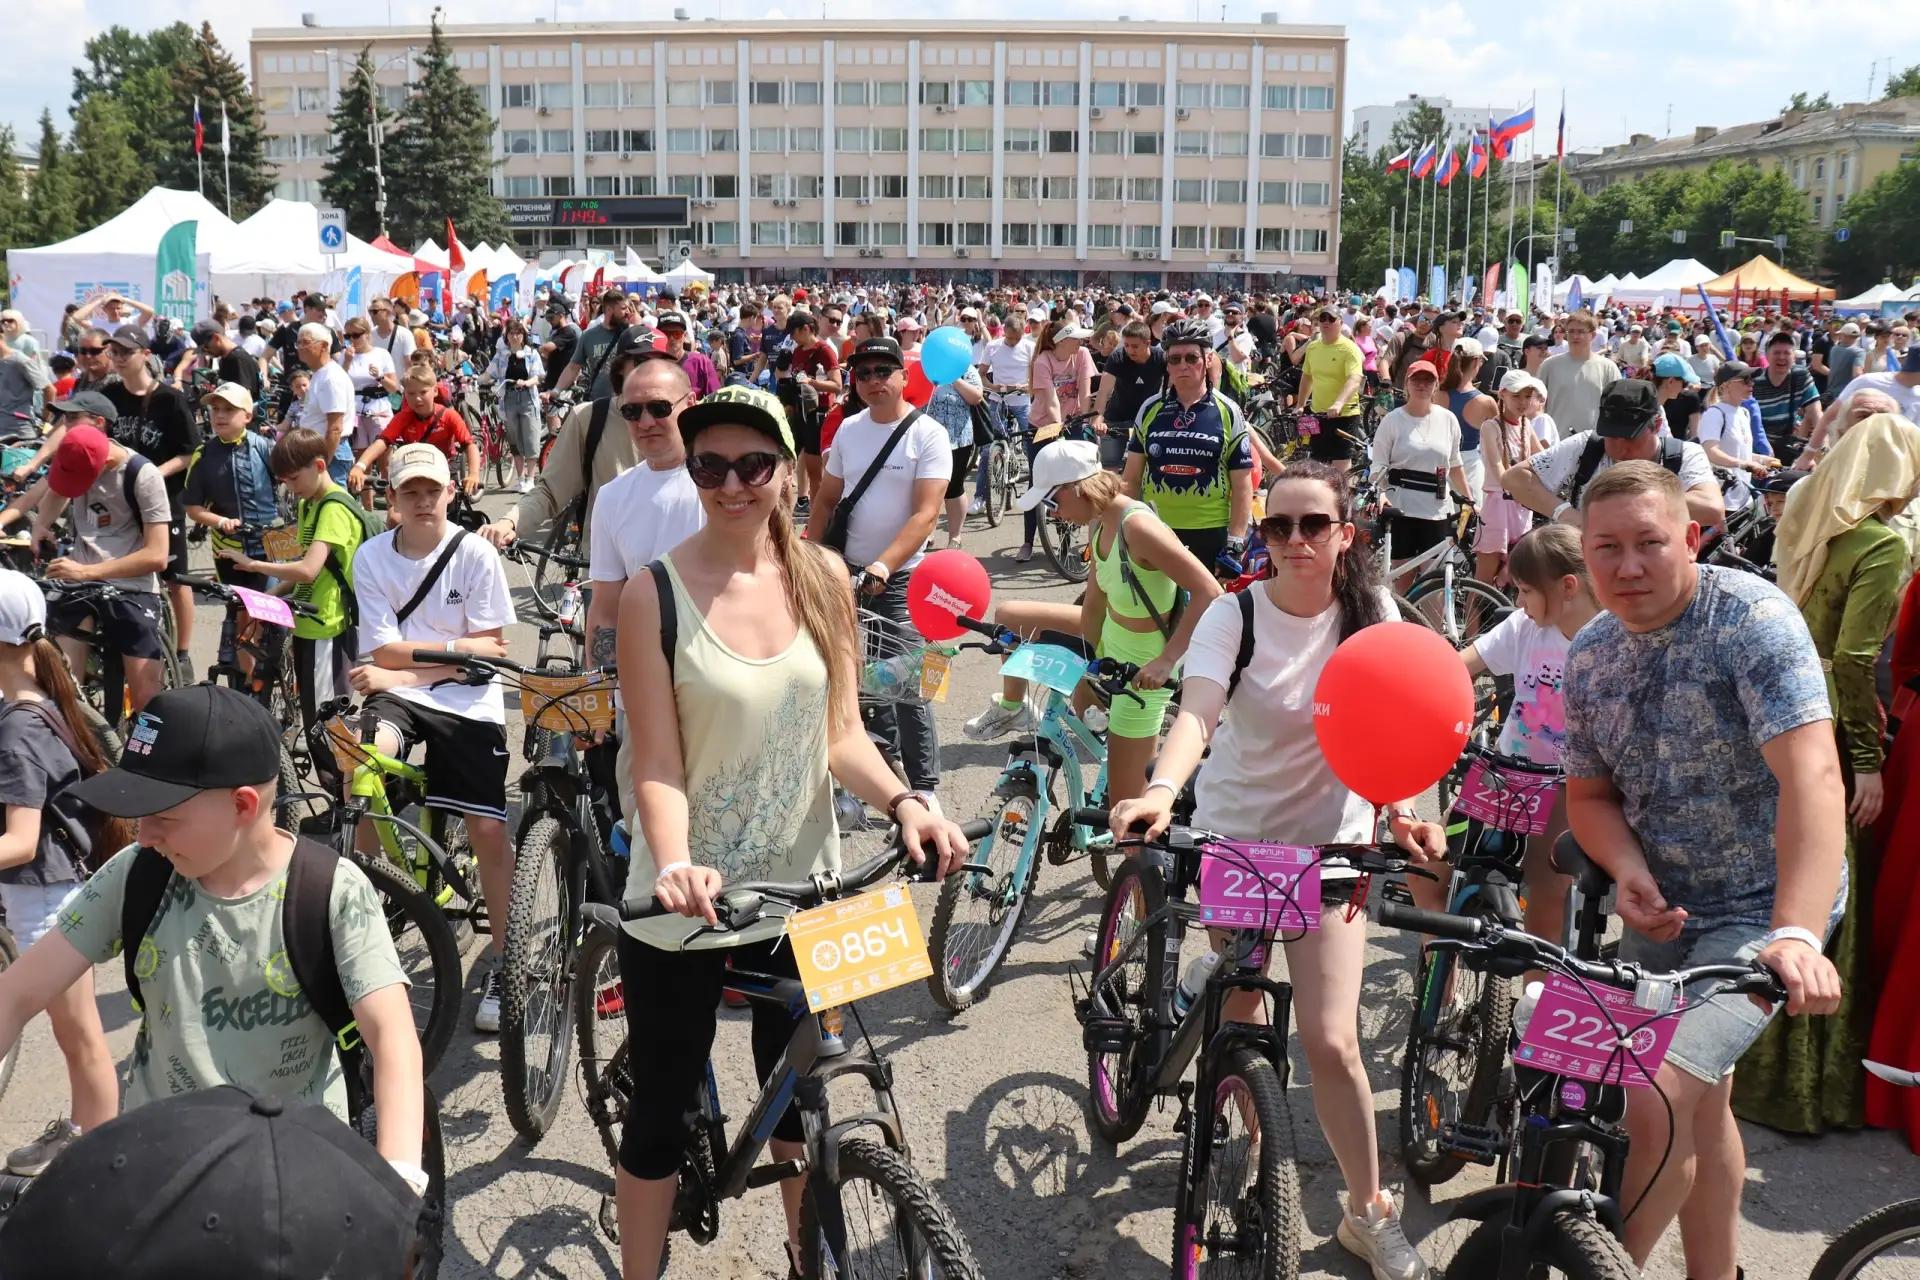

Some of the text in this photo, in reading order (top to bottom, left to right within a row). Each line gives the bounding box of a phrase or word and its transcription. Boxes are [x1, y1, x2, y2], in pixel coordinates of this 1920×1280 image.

[1148, 431, 1220, 443] MERIDA
[1166, 447, 1213, 457] MULTIVAN
[951, 601, 965, 612] Банк
[1025, 654, 1067, 676] 1517
[1474, 788, 1541, 814] 2223
[1223, 870, 1300, 900] 2221
[279, 1033, 309, 1050] FEEL
[280, 1049, 306, 1066] EACH
